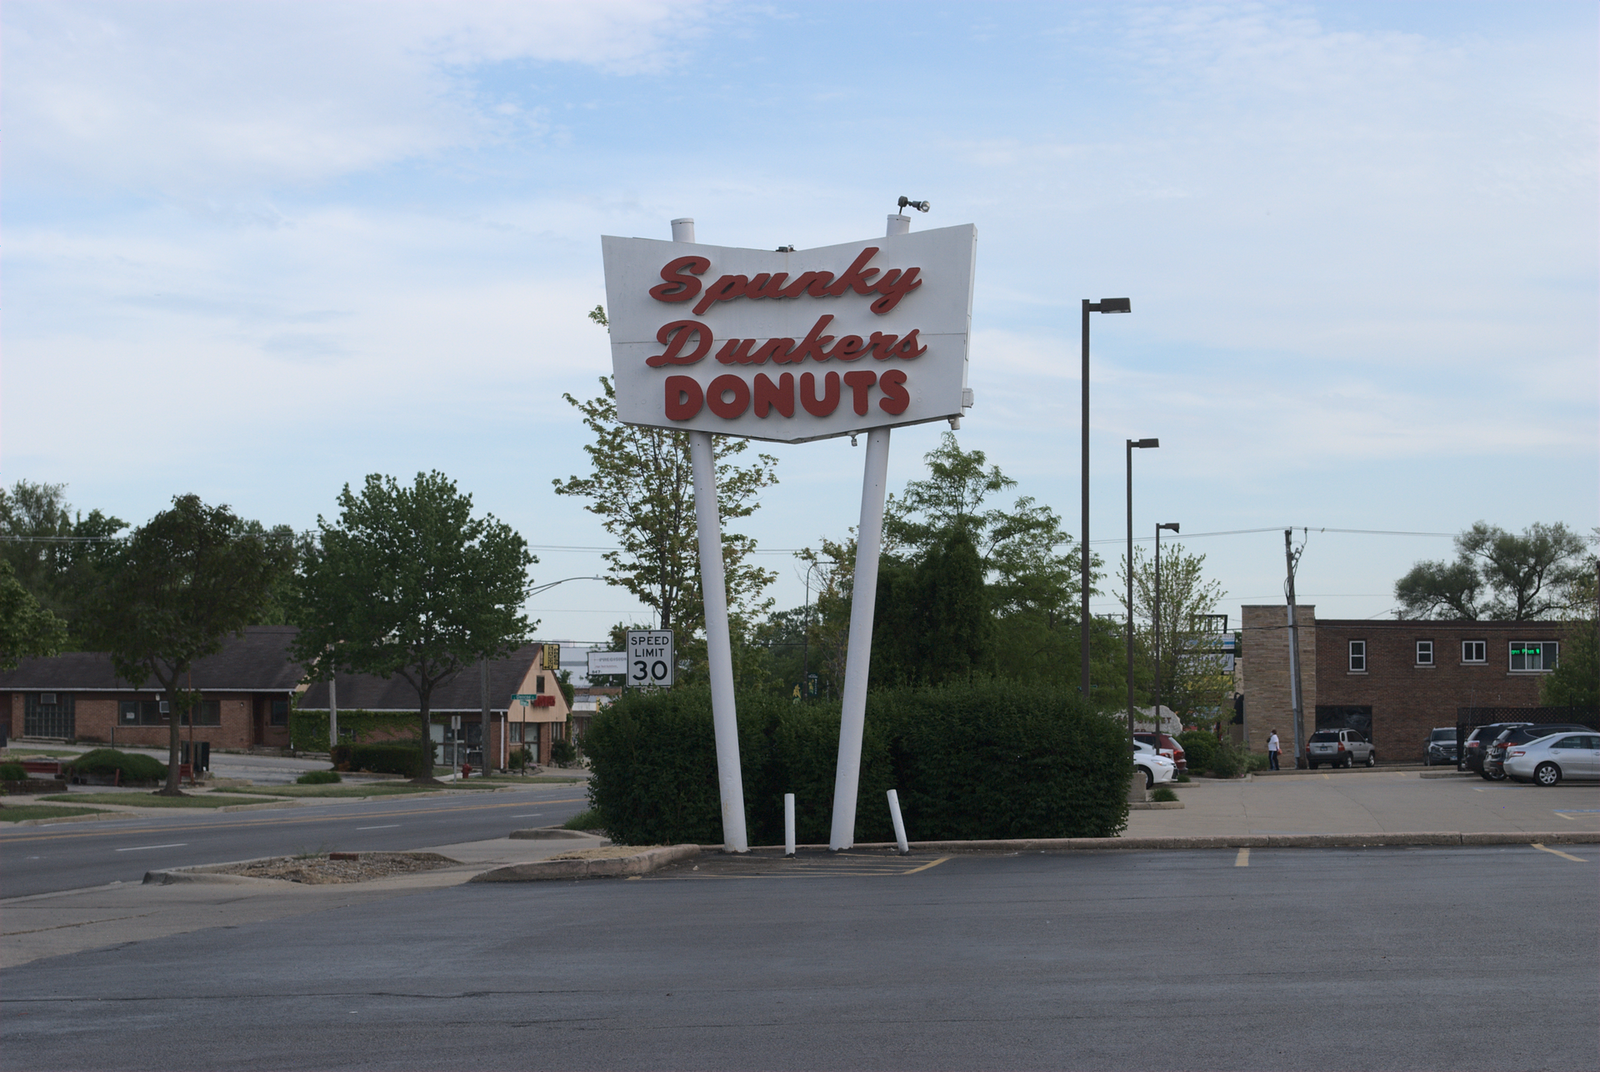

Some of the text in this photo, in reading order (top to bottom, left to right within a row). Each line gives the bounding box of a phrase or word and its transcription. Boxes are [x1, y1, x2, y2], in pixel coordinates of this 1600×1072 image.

[649, 247, 922, 315] Spunky
[645, 314, 927, 368] Dunkers
[664, 369, 910, 421] DONUTS
[631, 636, 669, 646] SPEED
[635, 648, 664, 657] LIMIT
[633, 660, 667, 680] 30
